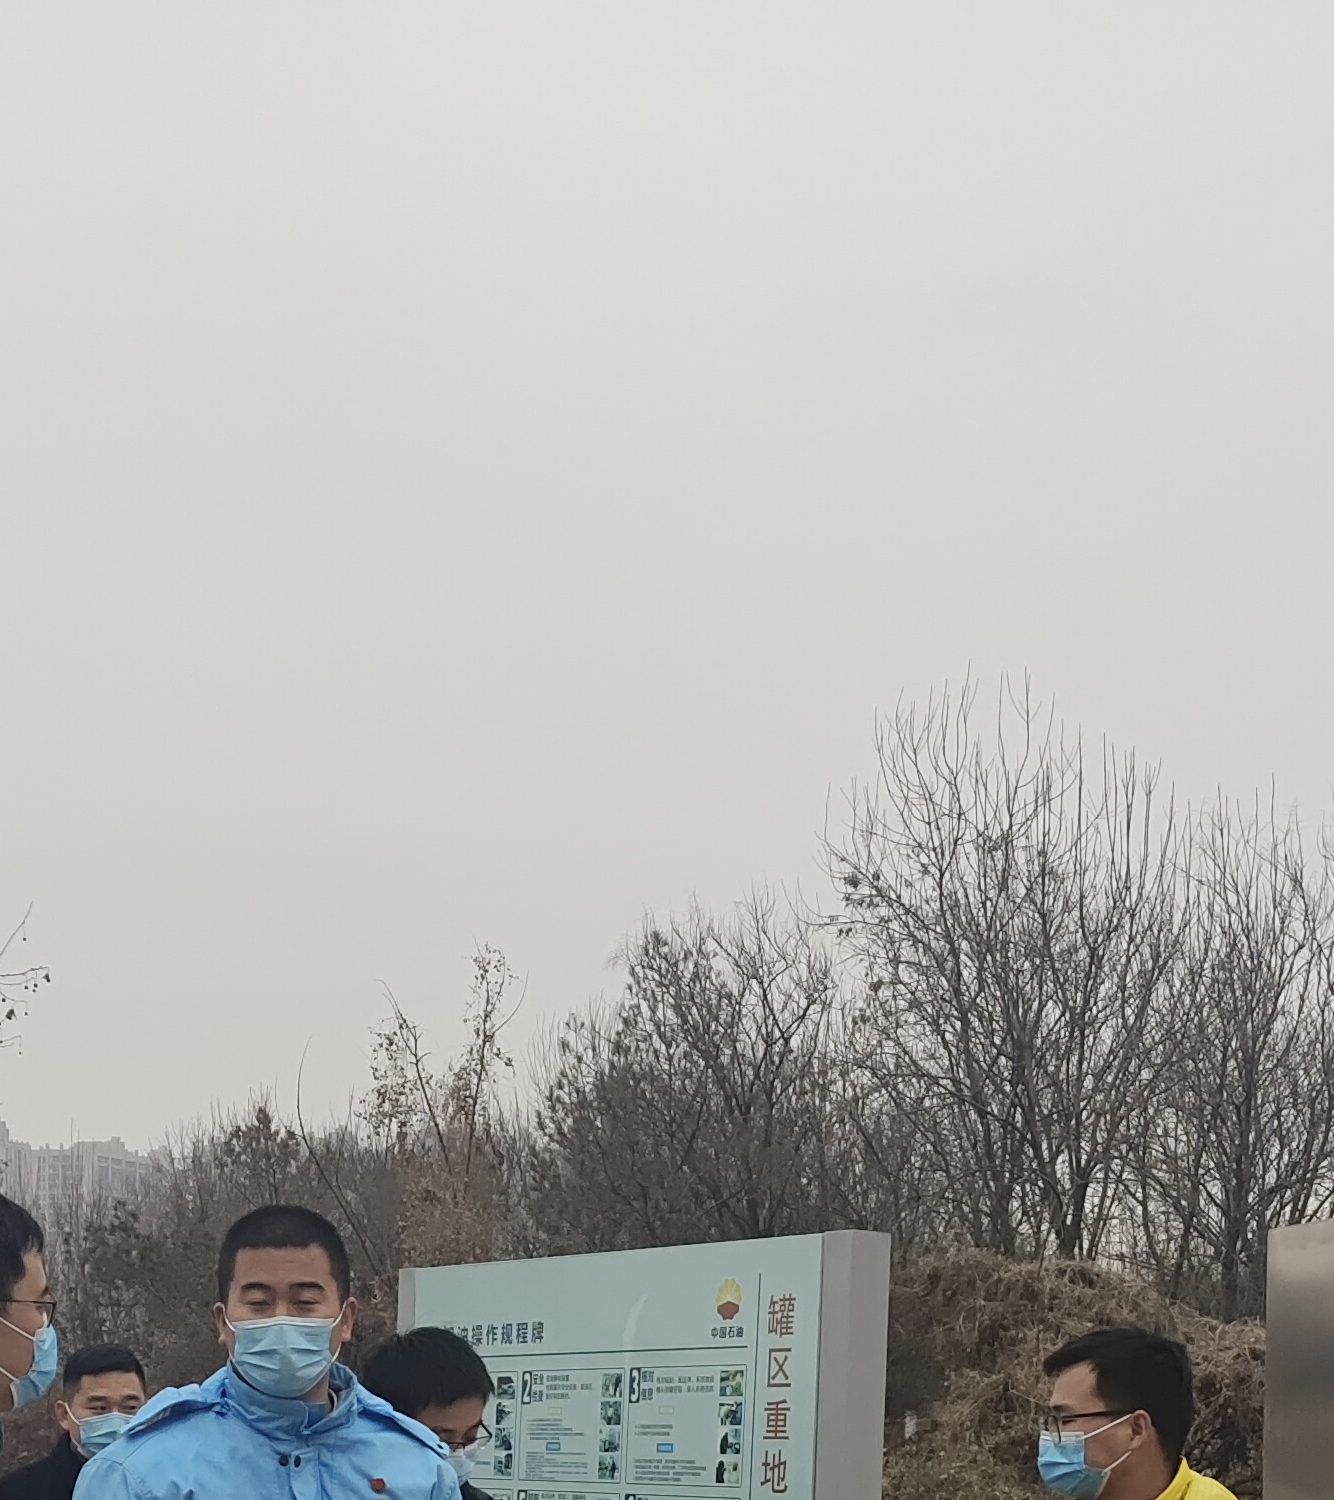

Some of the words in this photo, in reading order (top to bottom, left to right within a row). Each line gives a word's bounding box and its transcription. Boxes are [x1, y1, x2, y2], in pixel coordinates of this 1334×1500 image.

[710, 1325, 745, 1339] 中国石油
[522, 1372, 531, 1402] 2
[630, 1369, 640, 1402] 3
[760, 1292, 797, 1494] 罐区重地
